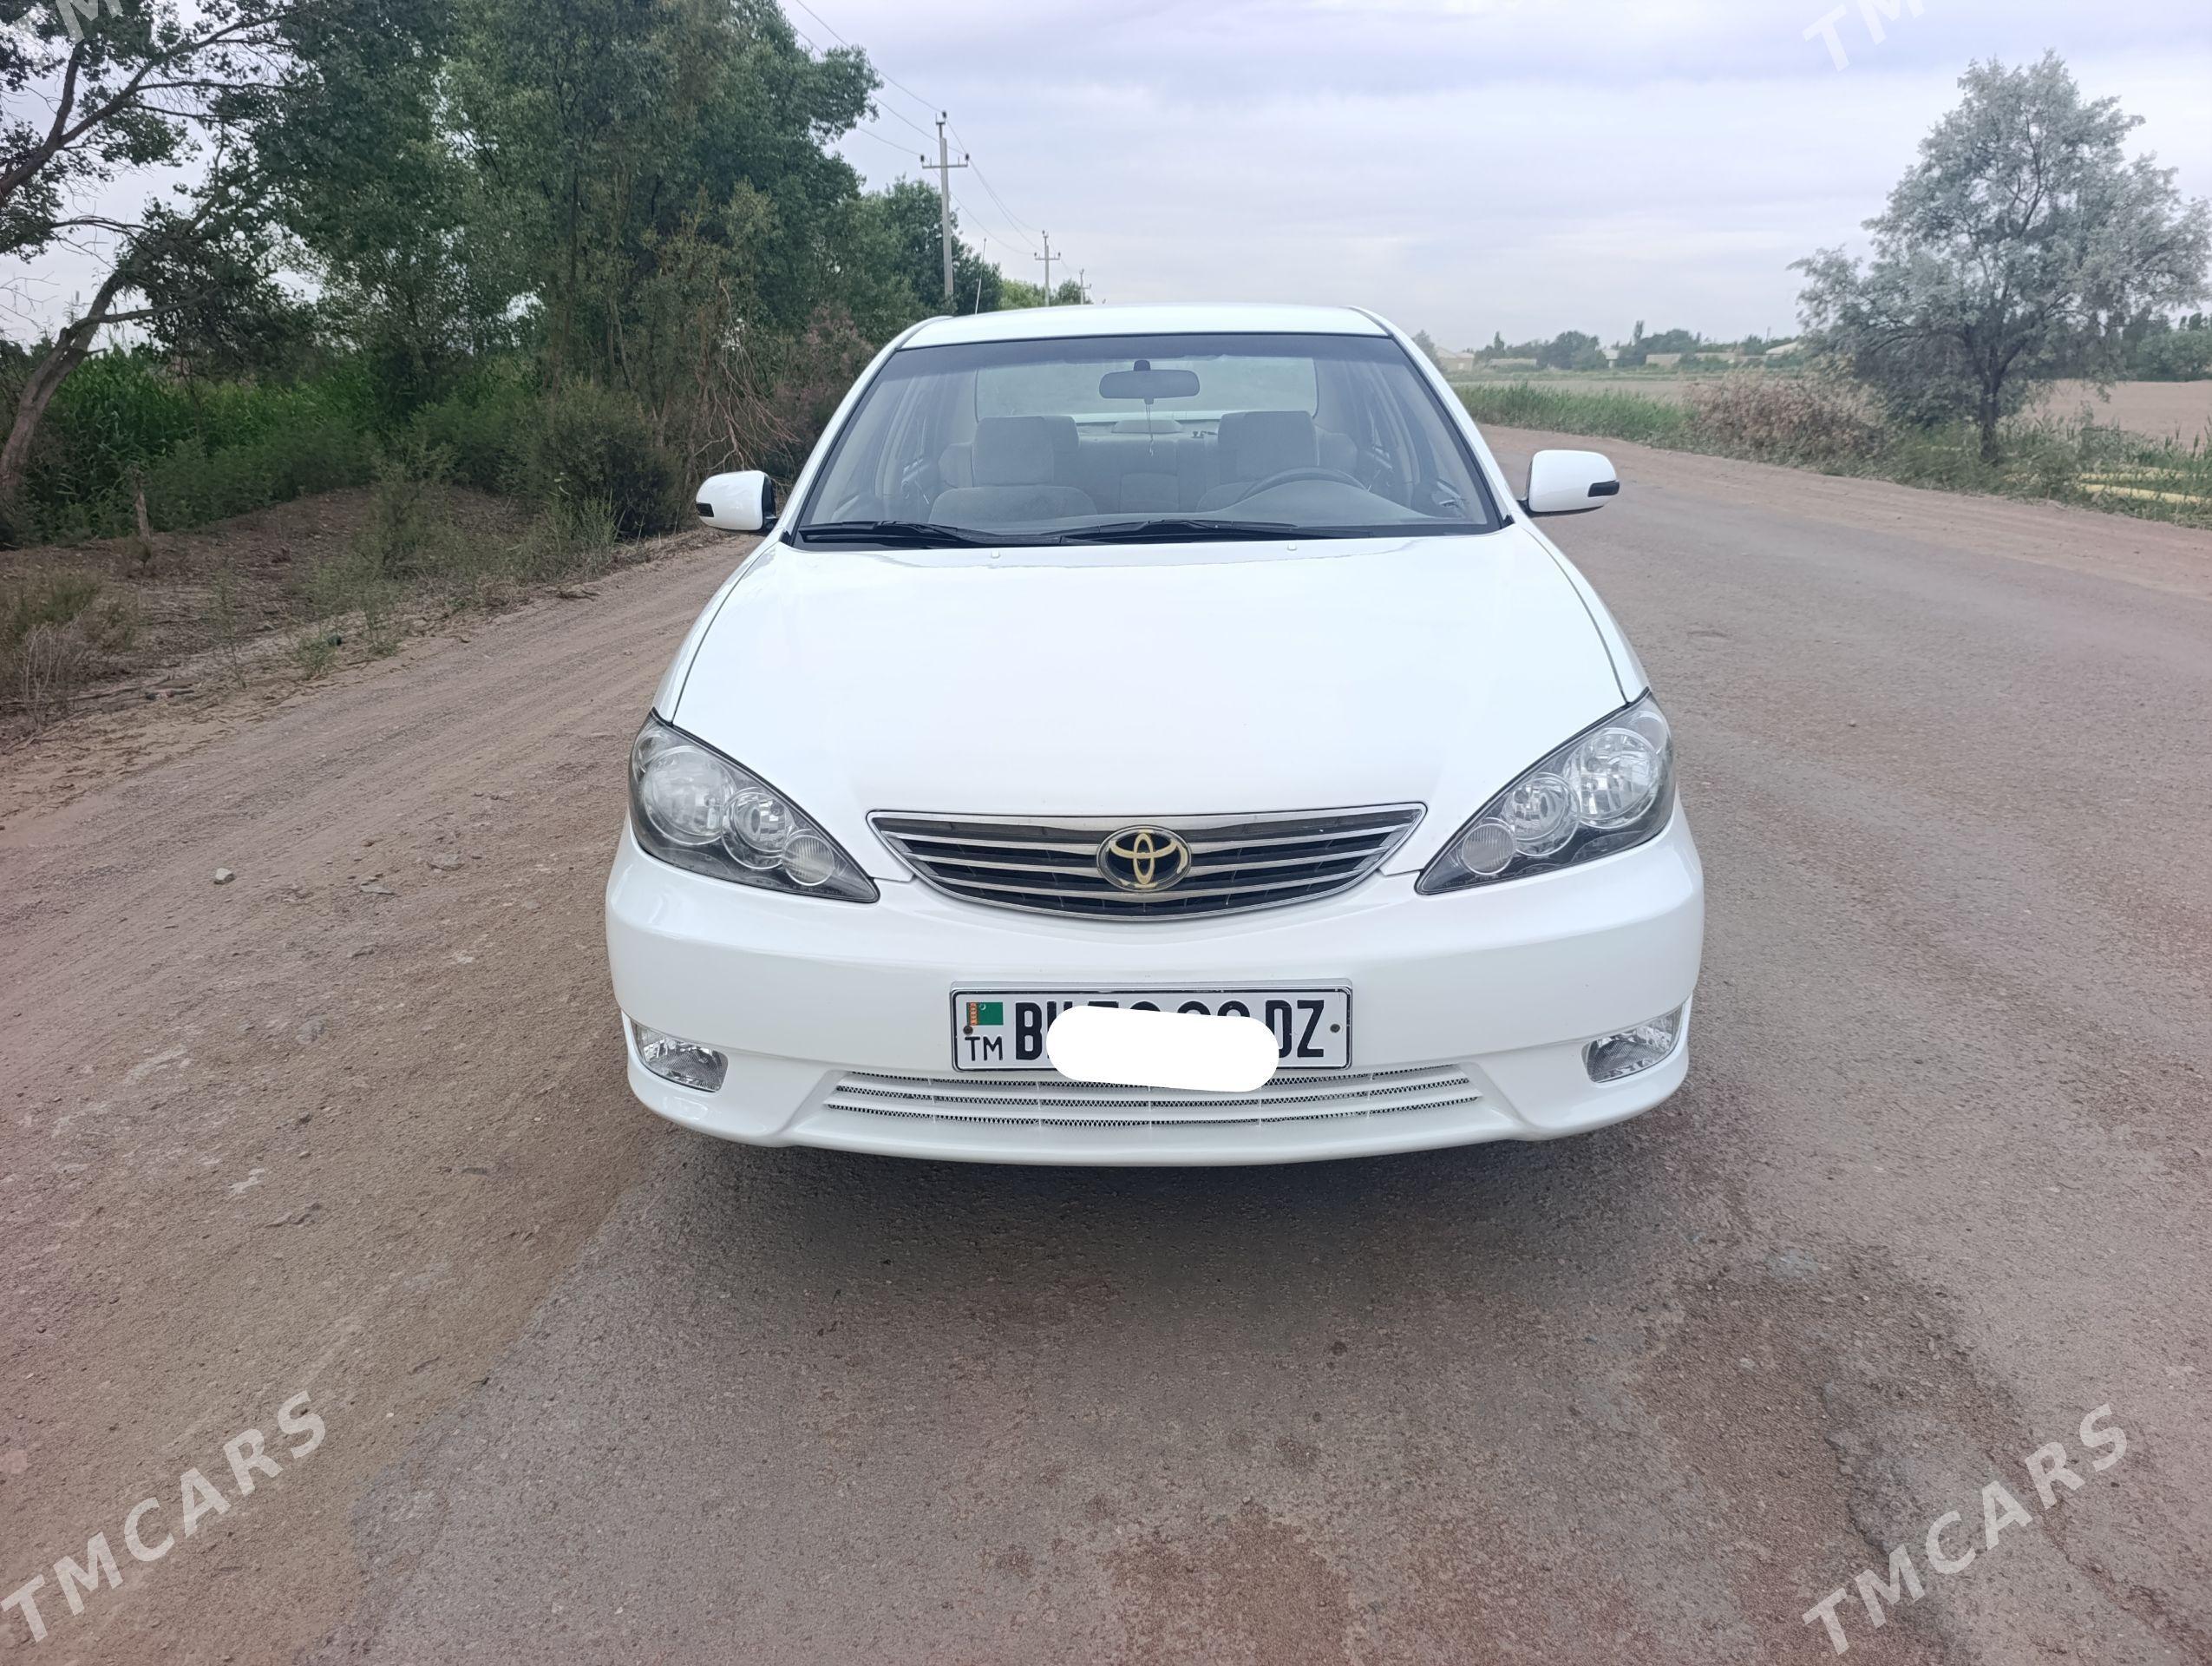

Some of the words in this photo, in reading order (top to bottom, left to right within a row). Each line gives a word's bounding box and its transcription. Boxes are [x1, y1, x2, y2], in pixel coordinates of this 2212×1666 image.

[965, 1036, 1003, 1061] TM
[1016, 1000, 1073, 1060] B
[1265, 1000, 1325, 1059] DZ
